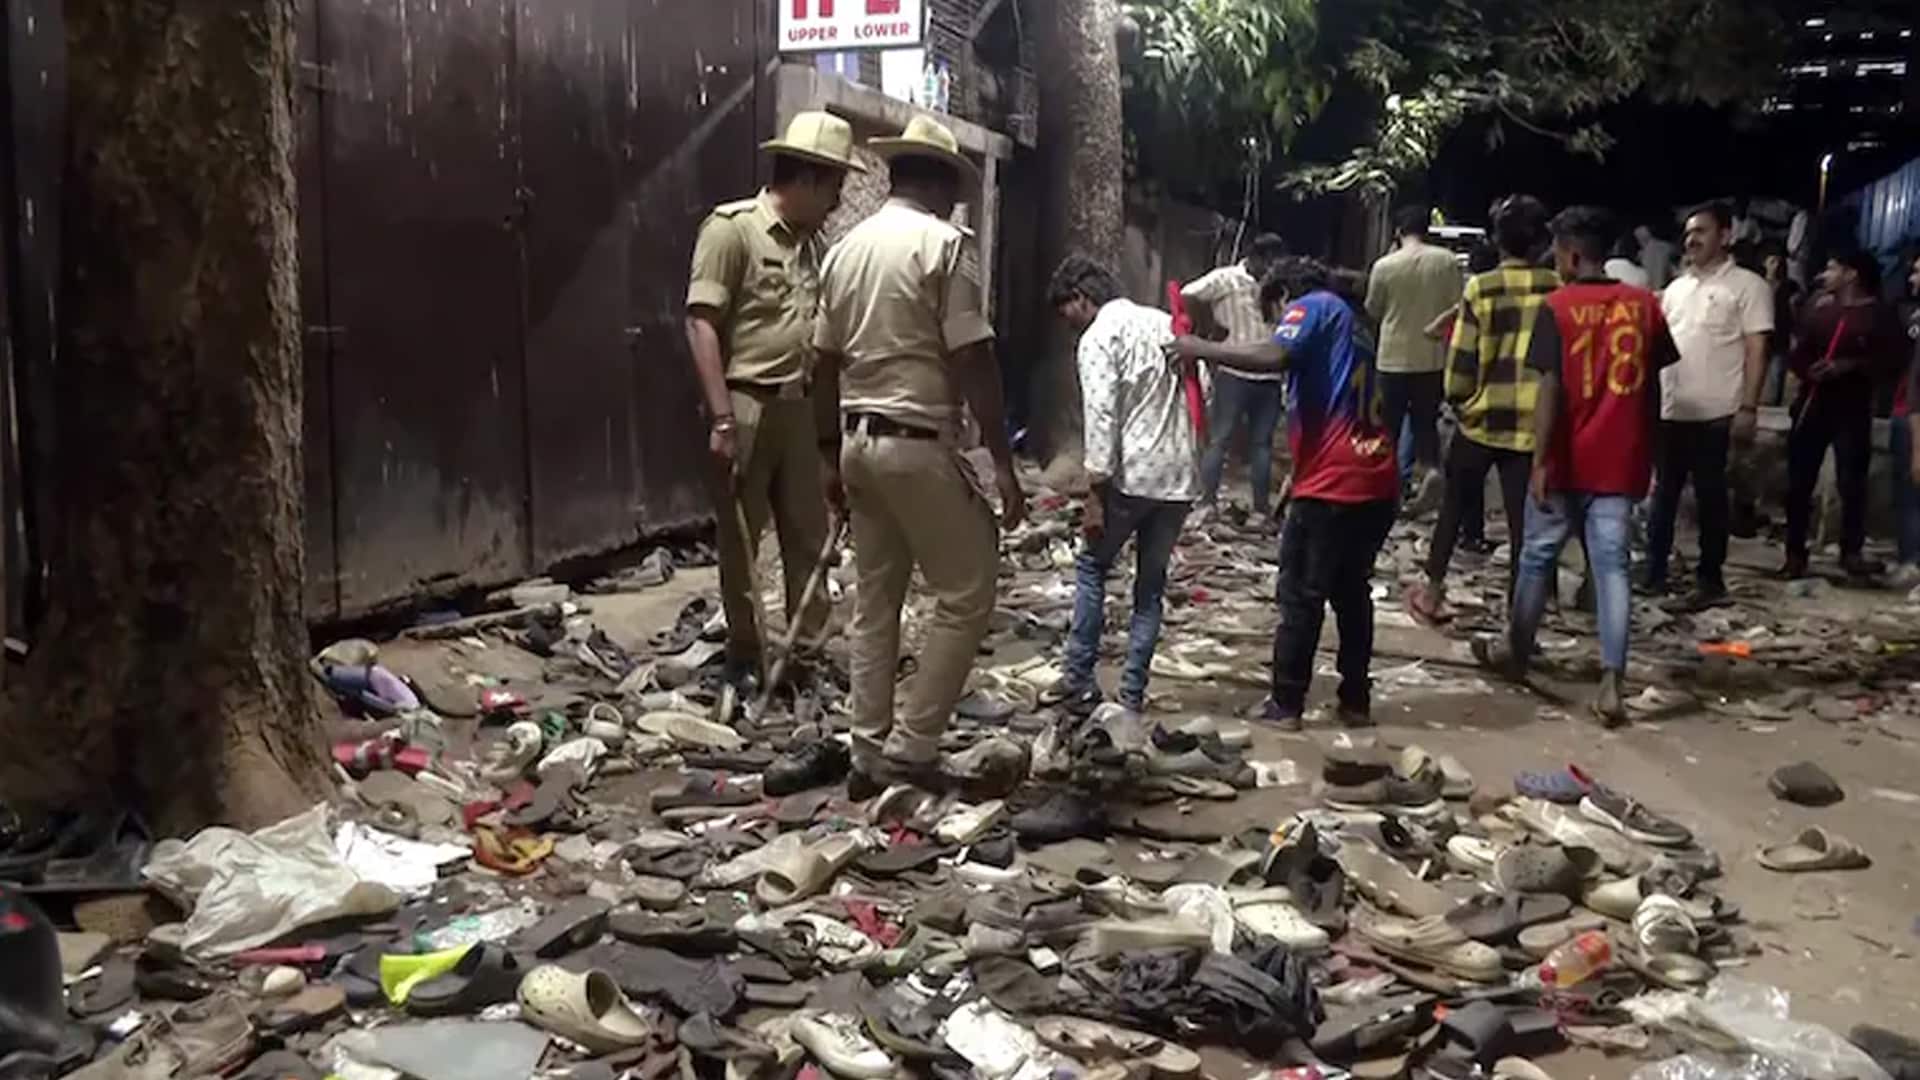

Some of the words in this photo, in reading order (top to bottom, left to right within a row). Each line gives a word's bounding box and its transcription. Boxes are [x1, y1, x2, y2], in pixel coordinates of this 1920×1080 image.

[788, 26, 838, 42] UPPER
[854, 22, 910, 39] LOWER
[1569, 325, 1644, 399] 18
